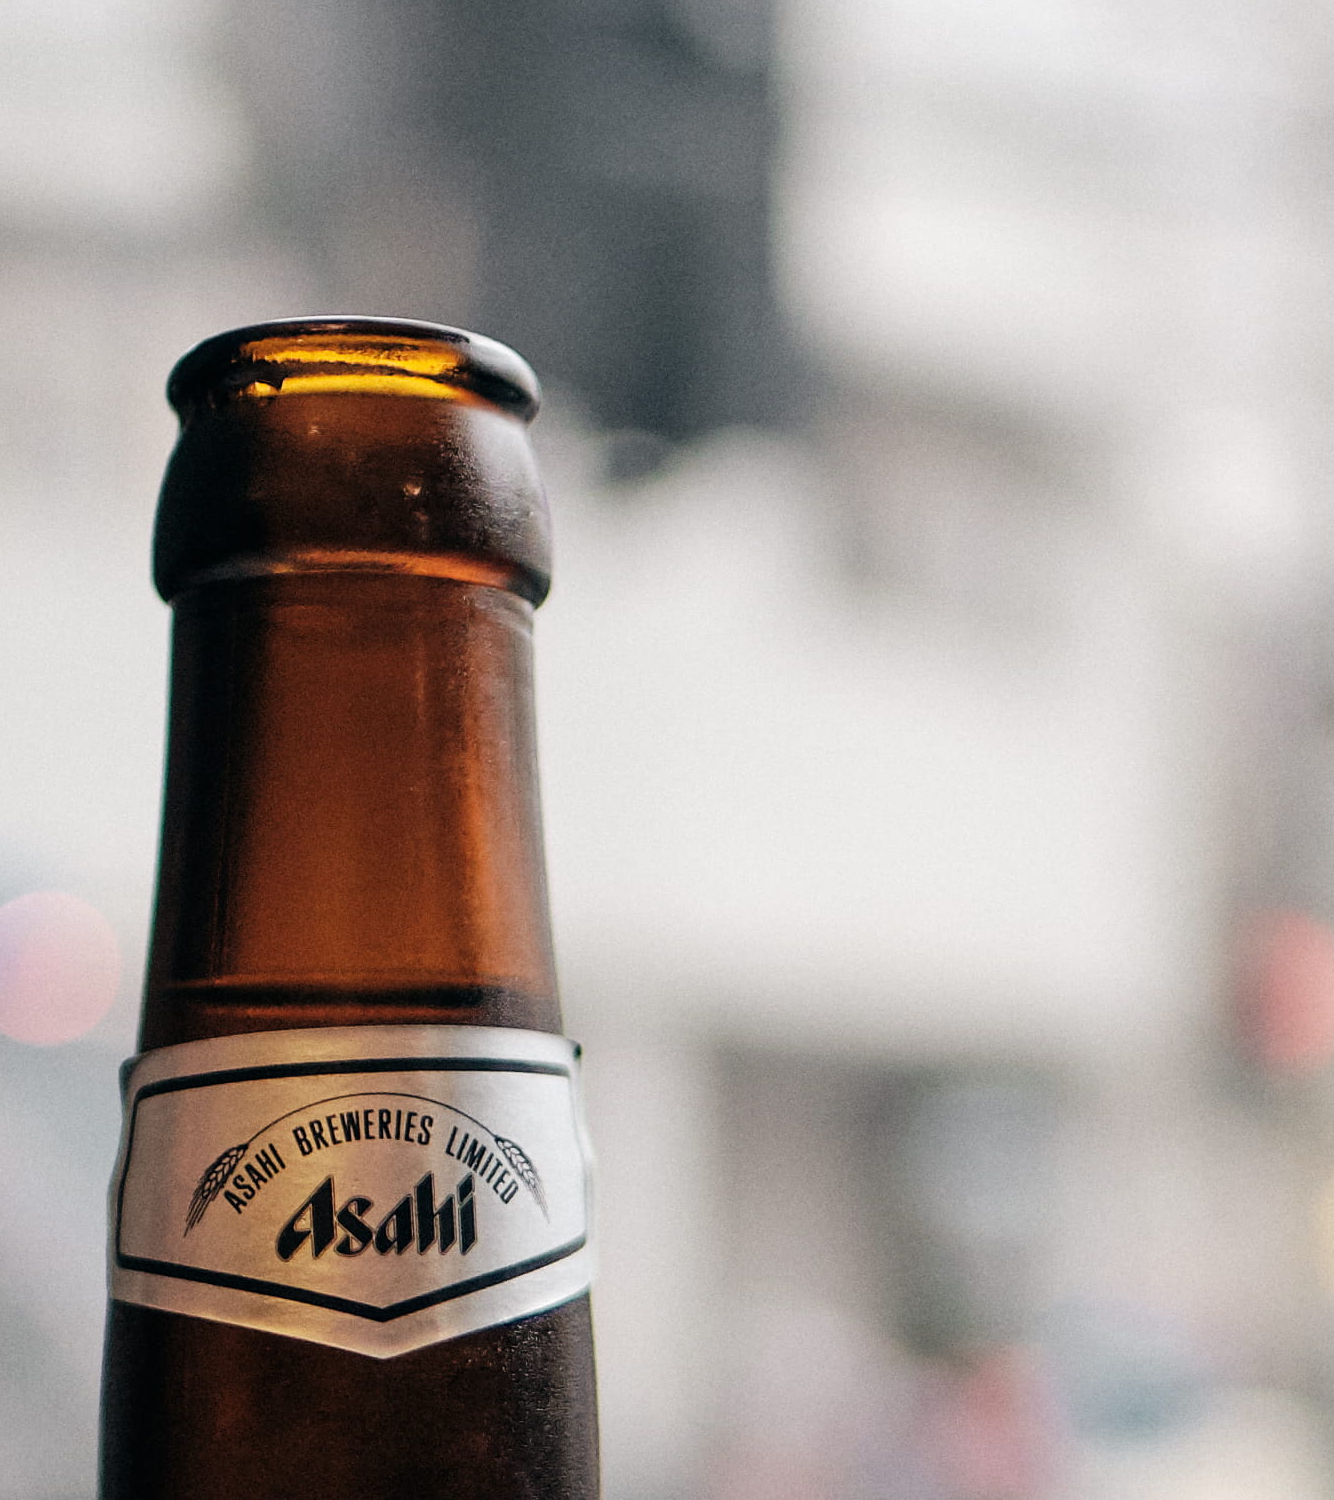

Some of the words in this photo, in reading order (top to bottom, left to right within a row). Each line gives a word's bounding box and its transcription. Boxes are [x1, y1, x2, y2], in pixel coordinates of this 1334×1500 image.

[223, 1143, 287, 1214] ASAHI
[292, 1108, 434, 1156] BREWERIES
[445, 1126, 519, 1204] LIMITED
[275, 1171, 478, 1262] Asahi
